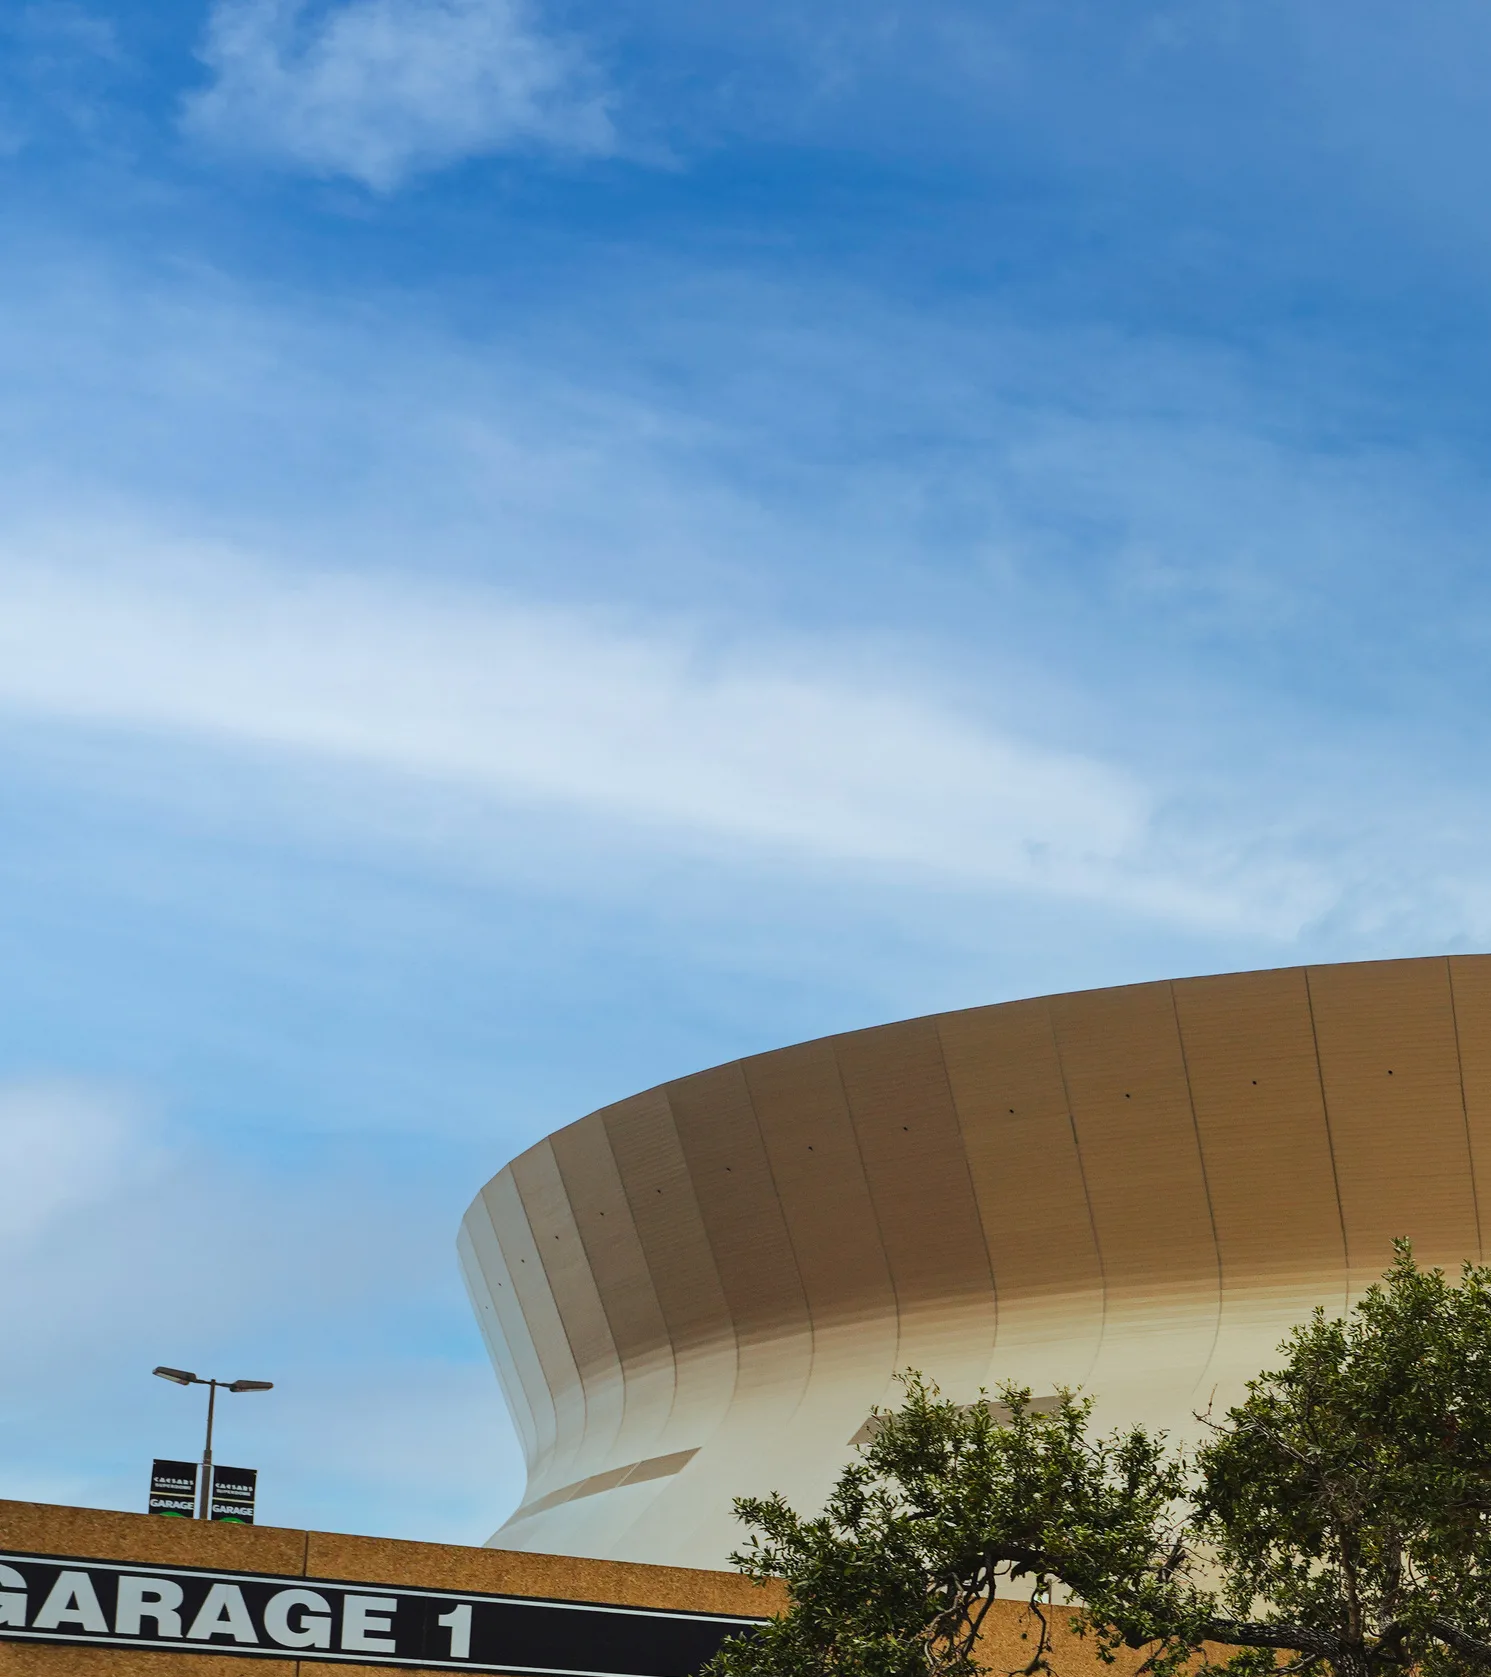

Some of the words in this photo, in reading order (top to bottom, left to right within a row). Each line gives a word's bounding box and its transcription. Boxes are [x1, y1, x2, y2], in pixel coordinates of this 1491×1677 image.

[153, 1476, 194, 1486] CAESARS
[215, 1482, 254, 1492] CAESARS
[150, 1498, 194, 1510] GARAGE
[212, 1504, 254, 1516] GARAGE
[438, 1604, 473, 1659] 1
